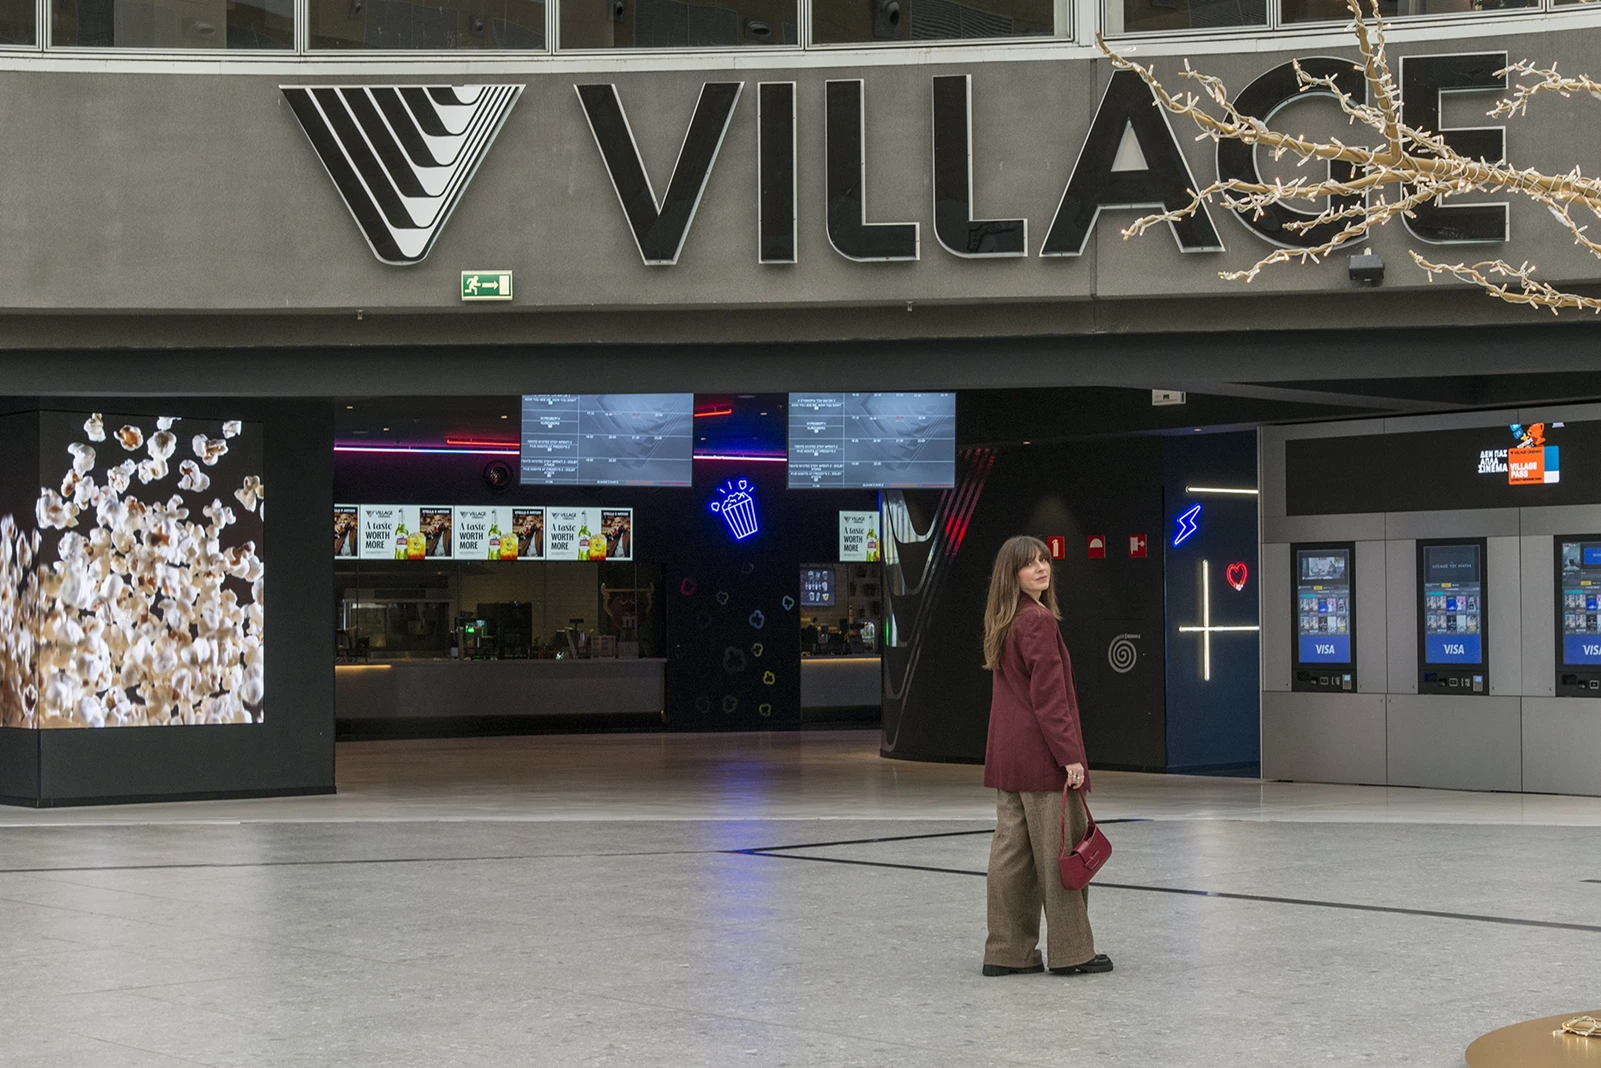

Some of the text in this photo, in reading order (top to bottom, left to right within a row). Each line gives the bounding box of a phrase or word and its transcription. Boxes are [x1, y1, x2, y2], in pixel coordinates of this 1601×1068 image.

[574, 51, 1510, 266] VILLAGE
[1510, 462, 1537, 471] VILLAGE
[1511, 470, 1528, 478] PASS
[366, 521, 372, 530] A
[460, 522, 486, 531] A taste
[844, 527, 849, 535] A
[365, 531, 390, 540] WORTH
[460, 532, 483, 540] WORTH
[551, 533, 574, 541] WORTH
[844, 535, 863, 543] WORTH
[366, 541, 384, 549] MORE
[460, 541, 479, 550] MORE
[551, 542, 569, 550] MORE
[844, 544, 859, 552] MORE
[1315, 644, 1335, 654] VISA
[1443, 644, 1465, 655] VISA
